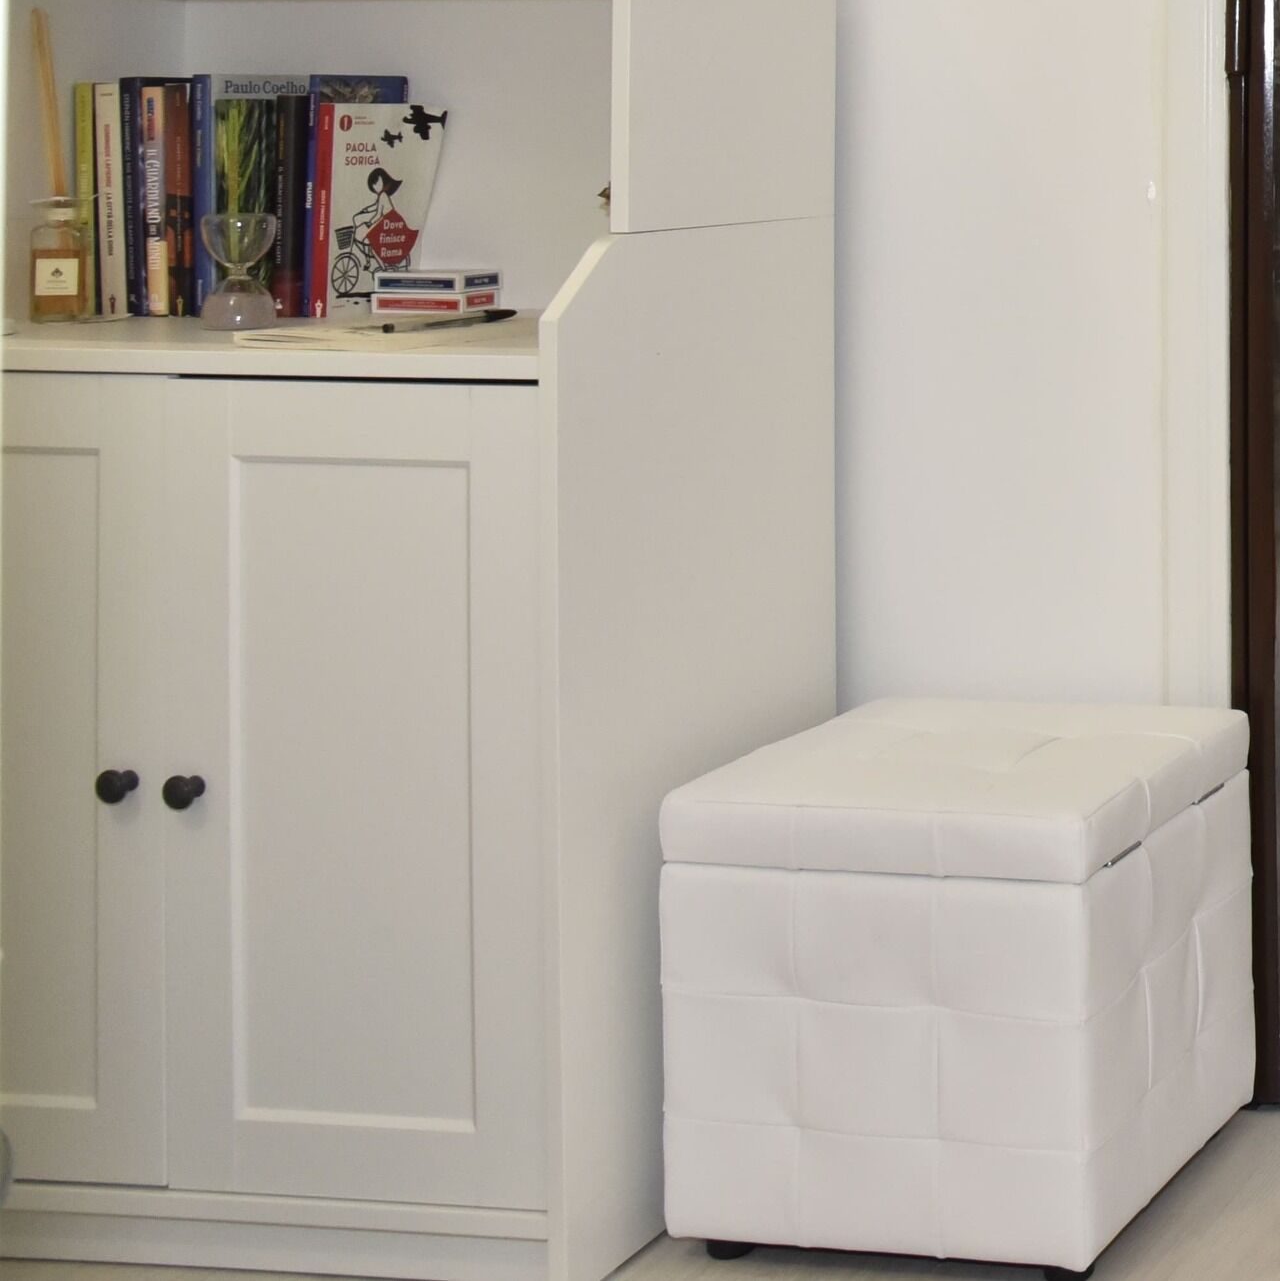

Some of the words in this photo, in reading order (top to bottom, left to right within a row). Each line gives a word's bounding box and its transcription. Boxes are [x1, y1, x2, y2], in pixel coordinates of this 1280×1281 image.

[224, 80, 260, 94] Paulo
[262, 80, 306, 94] Coelho
[146, 149, 158, 158] IL
[345, 142, 377, 153] PAOLA
[344, 155, 381, 166] SORIGA
[146, 159, 161, 223] GUARDIANO
[305, 181, 313, 209] Roma
[383, 218, 404, 230] Dove
[379, 232, 406, 244] finisce
[146, 236, 160, 270] MONDI
[380, 246, 402, 258] Roma
